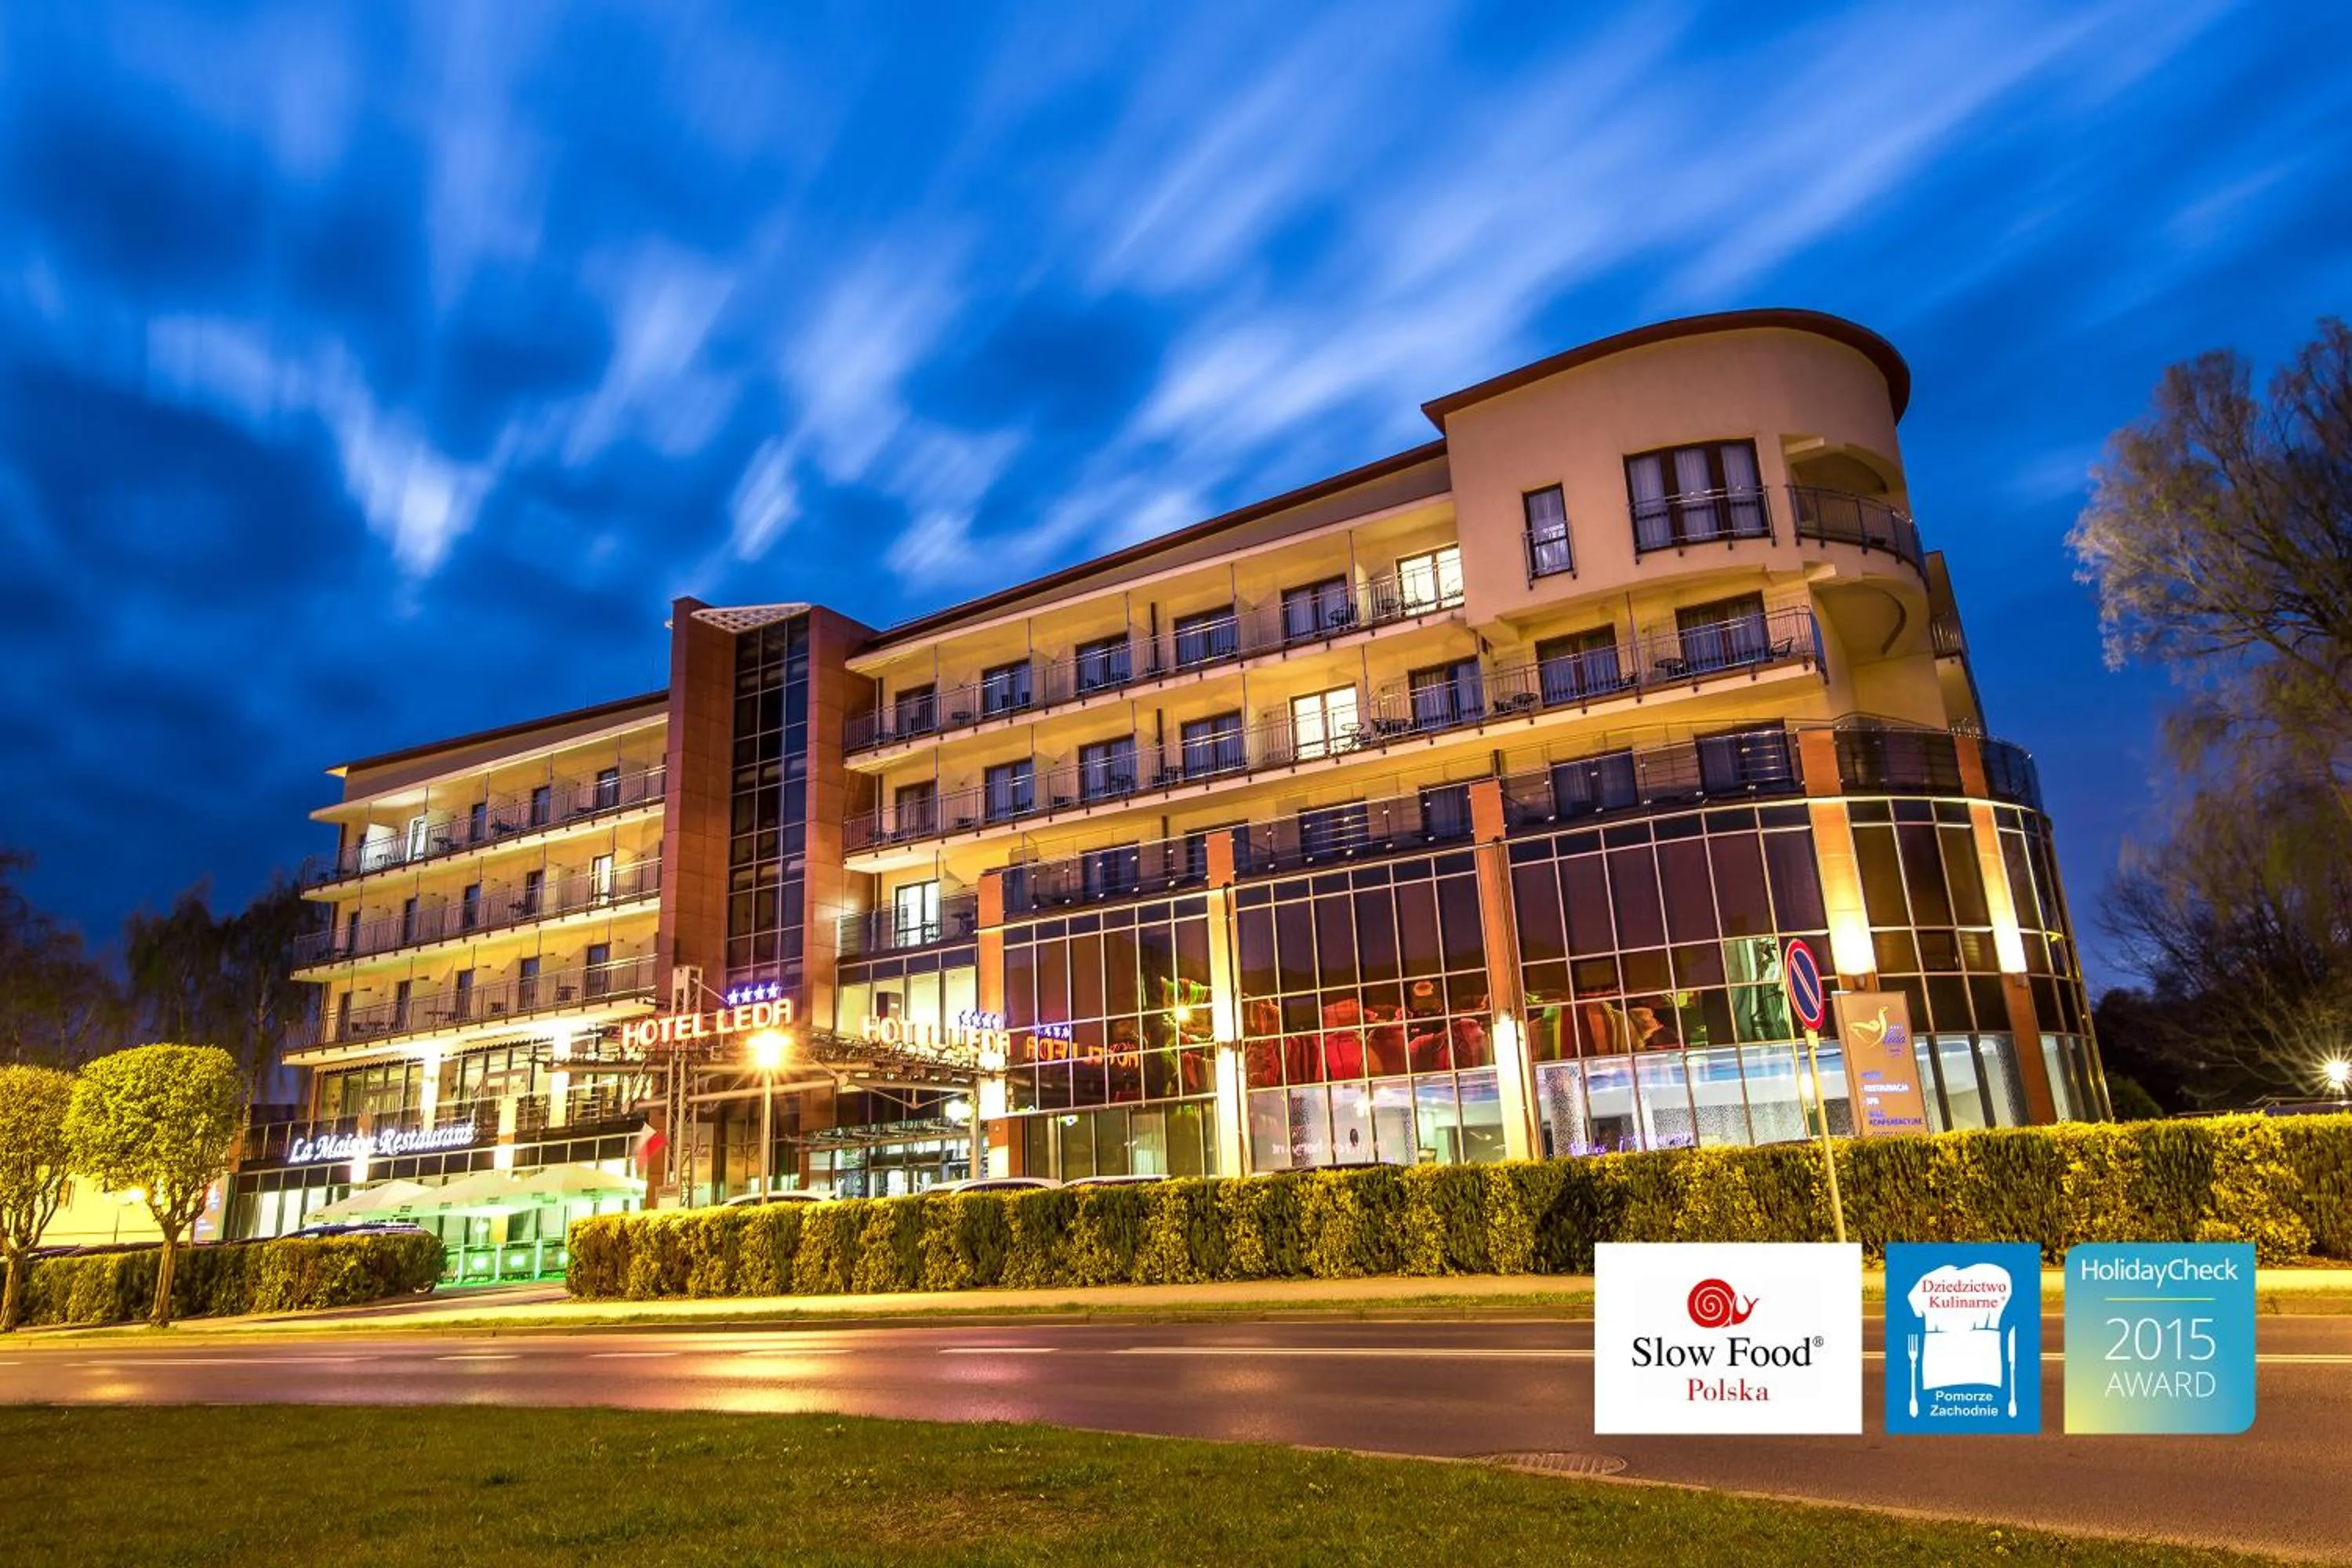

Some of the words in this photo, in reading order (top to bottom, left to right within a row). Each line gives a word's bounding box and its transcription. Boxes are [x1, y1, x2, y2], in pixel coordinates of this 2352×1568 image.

[621, 1012, 709, 1050] HOTEL
[715, 998, 793, 1035] LEDA
[289, 1137, 314, 1163] La
[379, 1123, 475, 1156] Restaurant
